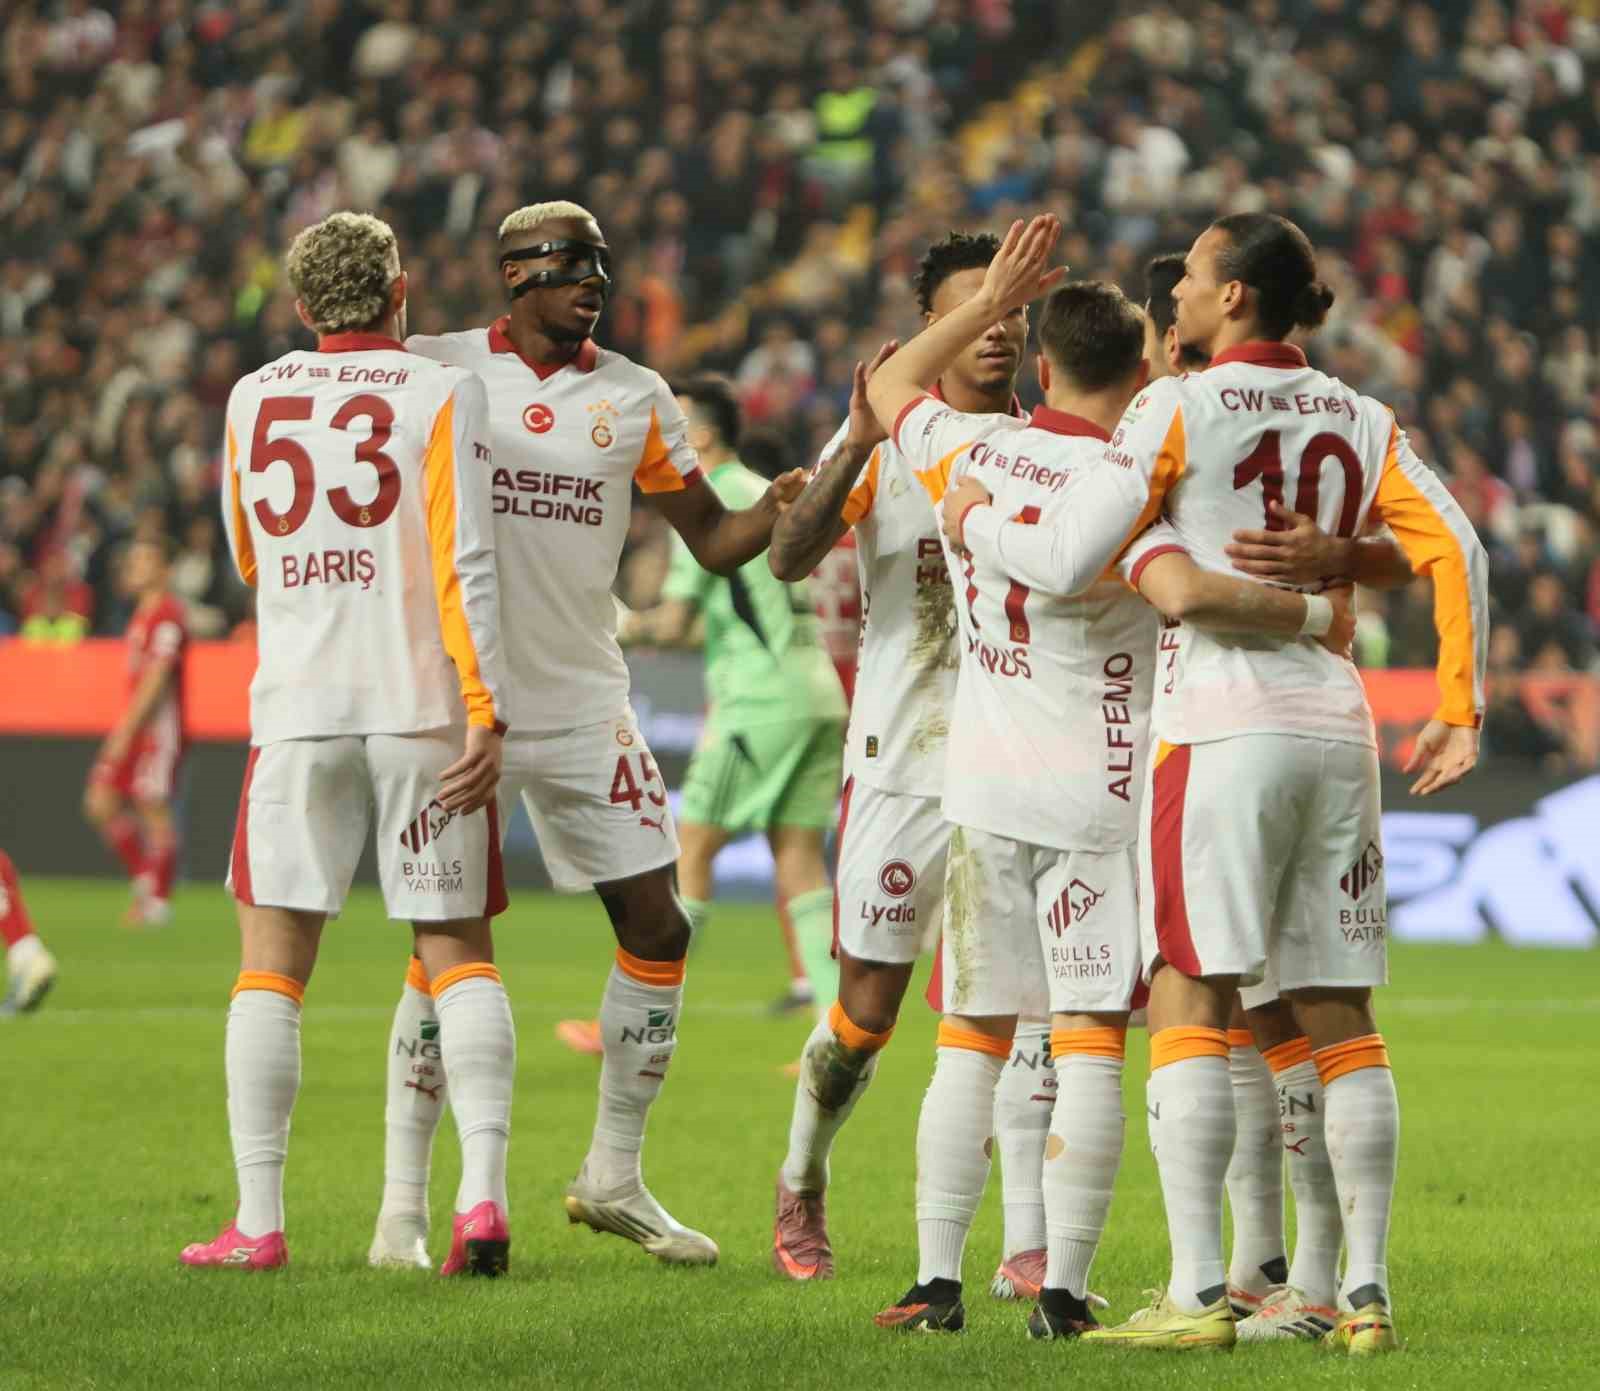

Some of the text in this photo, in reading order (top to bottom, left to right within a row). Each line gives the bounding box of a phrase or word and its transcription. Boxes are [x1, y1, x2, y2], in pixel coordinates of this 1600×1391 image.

[1220, 389, 1264, 412] CW
[250, 393, 402, 537] 53
[1234, 429, 1364, 537] 10
[281, 549, 376, 590] BARIŞ
[1103, 652, 1134, 802] ALFEMO
[609, 751, 667, 812] 45
[403, 860, 462, 876] BULLS
[405, 877, 463, 893] YATIRIM
[861, 901, 916, 927] Lydia
[1051, 945, 1111, 962] BULLS
[1053, 963, 1112, 979] YATIRIM
